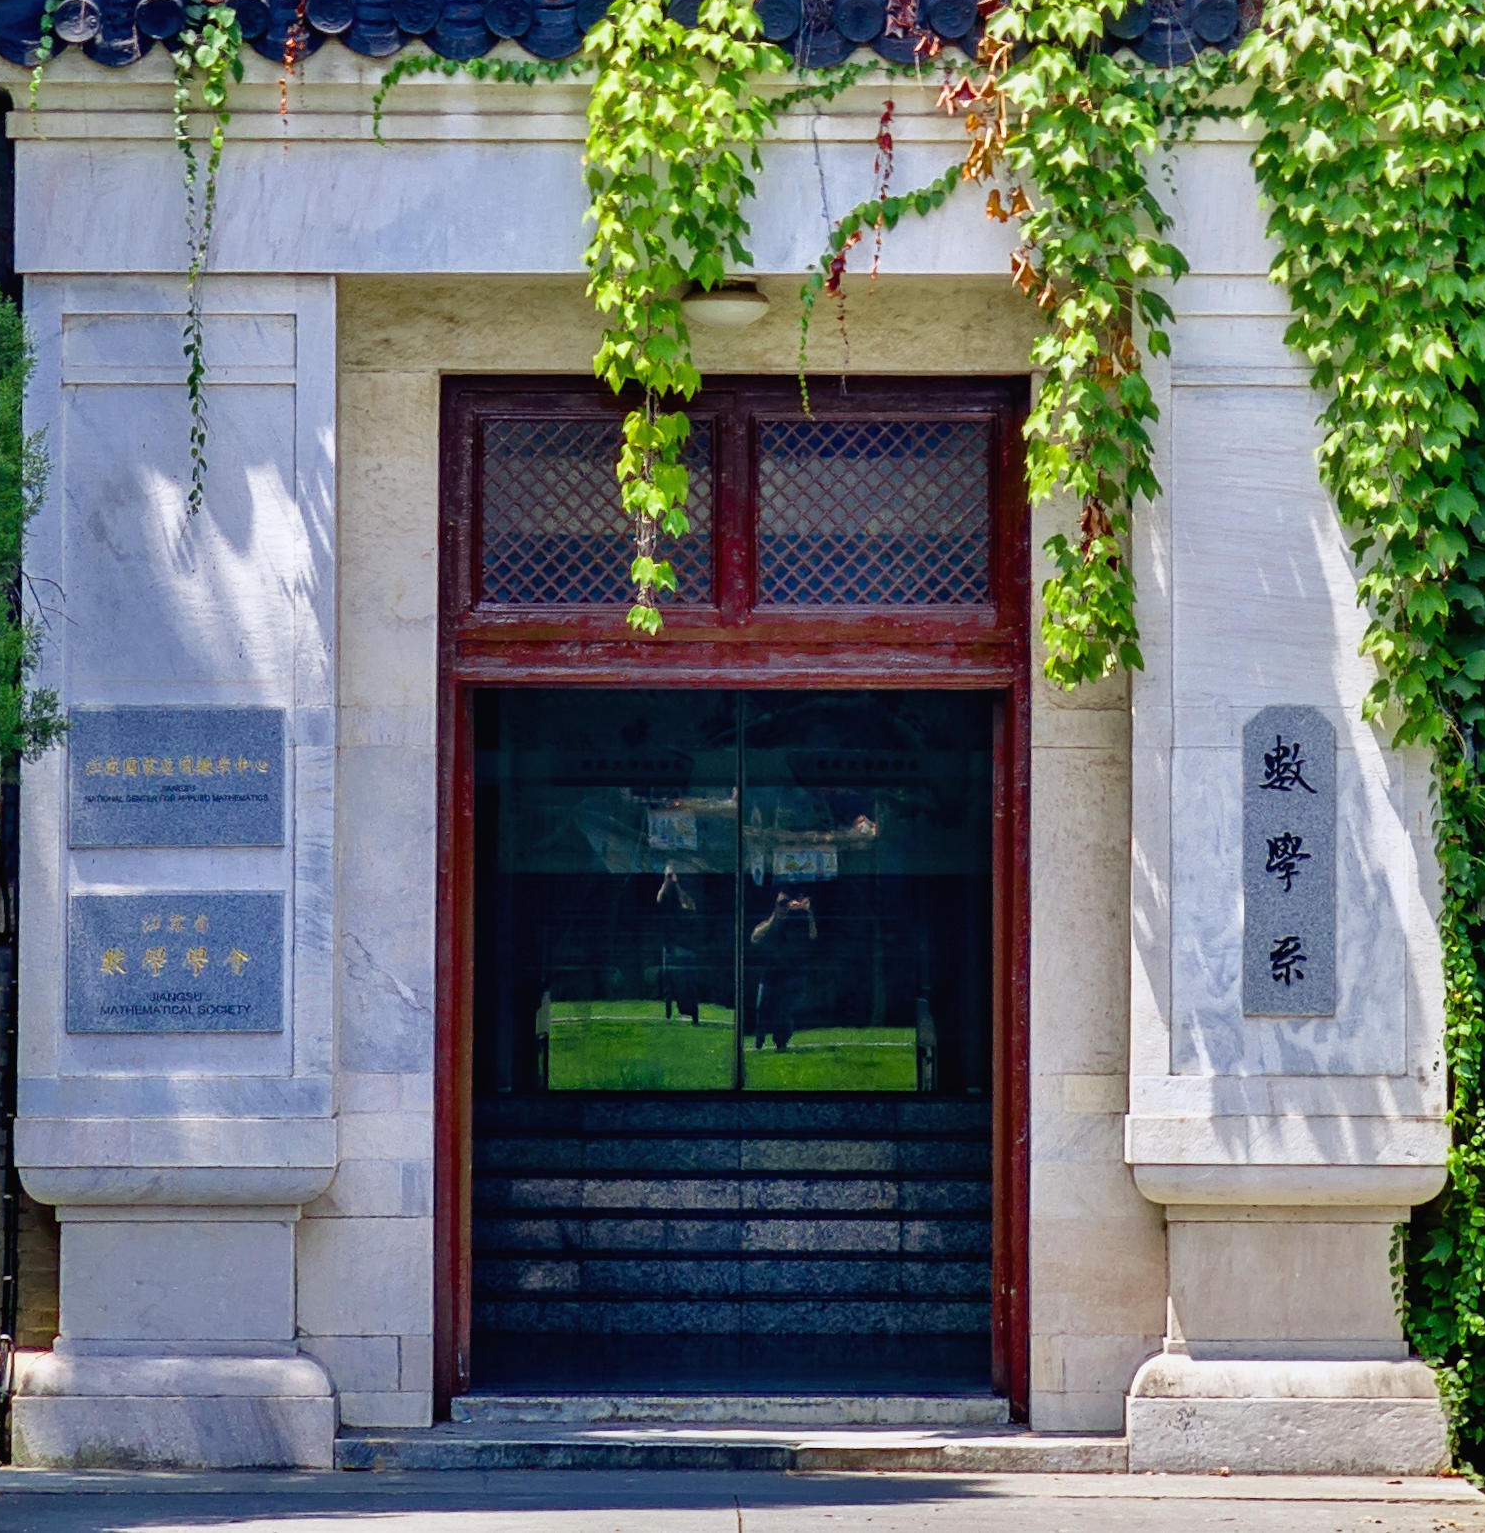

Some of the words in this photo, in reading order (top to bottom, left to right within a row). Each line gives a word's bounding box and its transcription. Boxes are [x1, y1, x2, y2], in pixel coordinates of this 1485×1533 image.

[149, 991, 203, 1002] JIANGSU
[99, 1004, 194, 1015] MATHEMATICAL
[197, 1004, 252, 1015] SOCIETY
